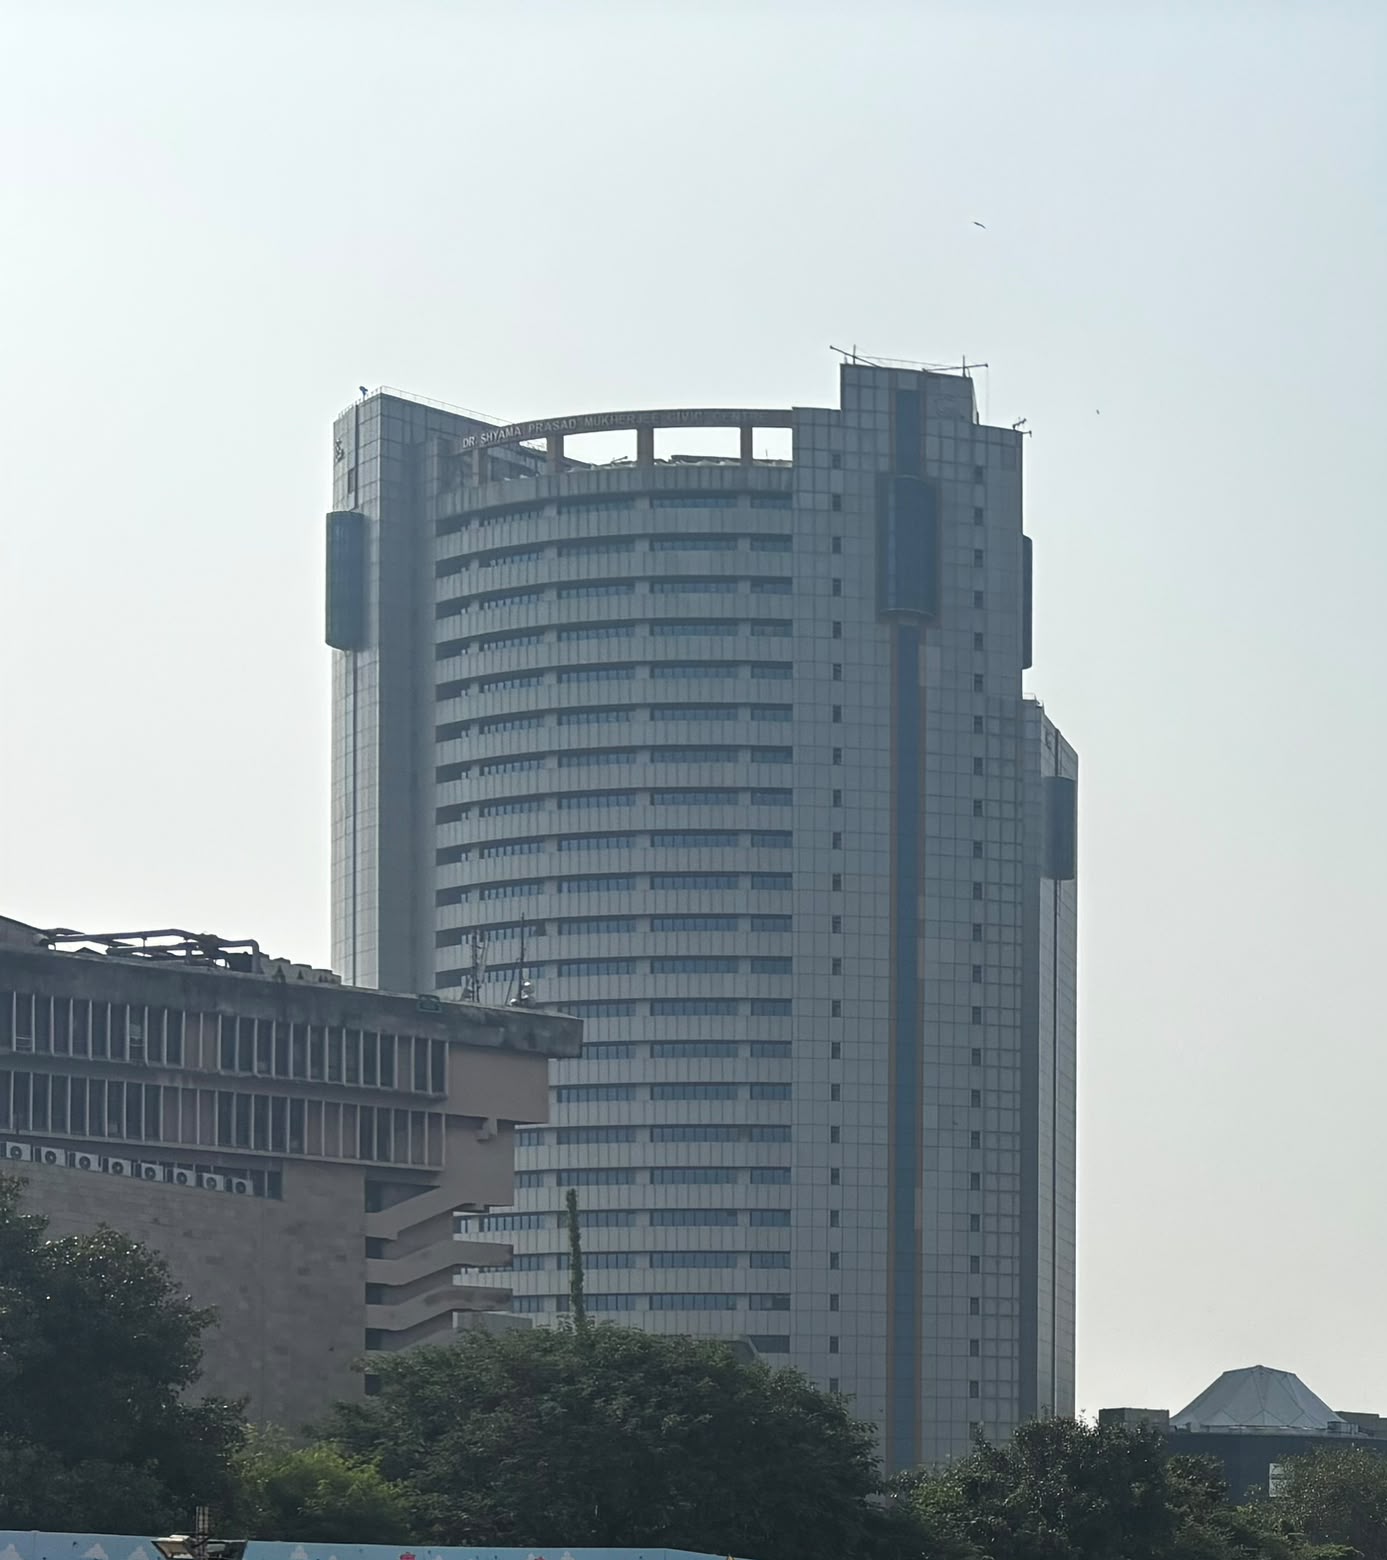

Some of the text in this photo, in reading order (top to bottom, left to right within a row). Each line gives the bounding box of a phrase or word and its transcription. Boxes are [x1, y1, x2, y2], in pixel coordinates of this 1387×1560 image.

[480, 425, 522, 445] SHYAMA
[528, 418, 577, 434] PRASAD
[584, 413, 660, 427] MUKHERJEE
[668, 411, 703, 424] CIVIC
